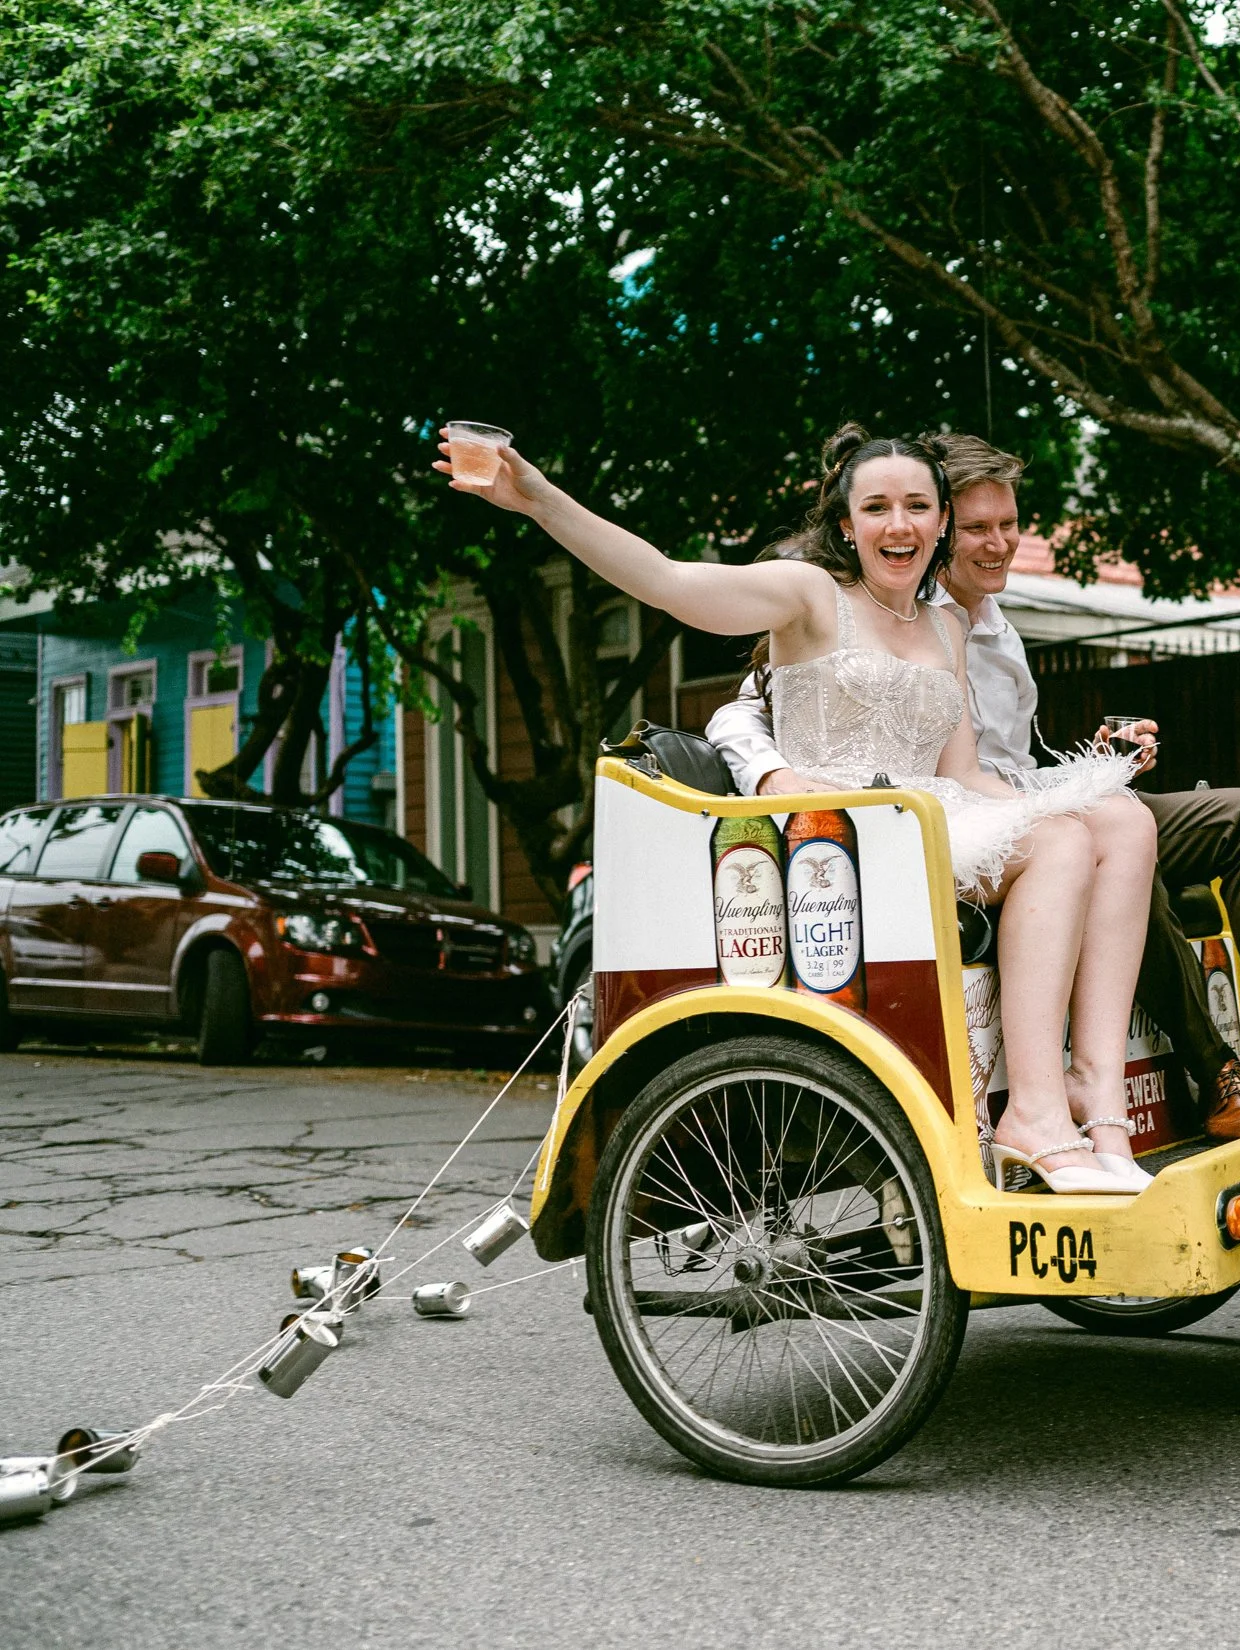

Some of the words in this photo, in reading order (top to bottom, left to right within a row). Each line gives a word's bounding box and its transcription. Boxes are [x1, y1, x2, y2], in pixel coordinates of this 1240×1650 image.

[715, 895, 783, 924] Yuengling
[789, 889, 858, 919] Yuengling
[724, 925, 779, 936] TRADITIONAL
[794, 921, 854, 943] LIGHT
[719, 935, 783, 958] LAGER
[805, 945, 844, 958] LAGER
[832, 960, 844, 969] 99
